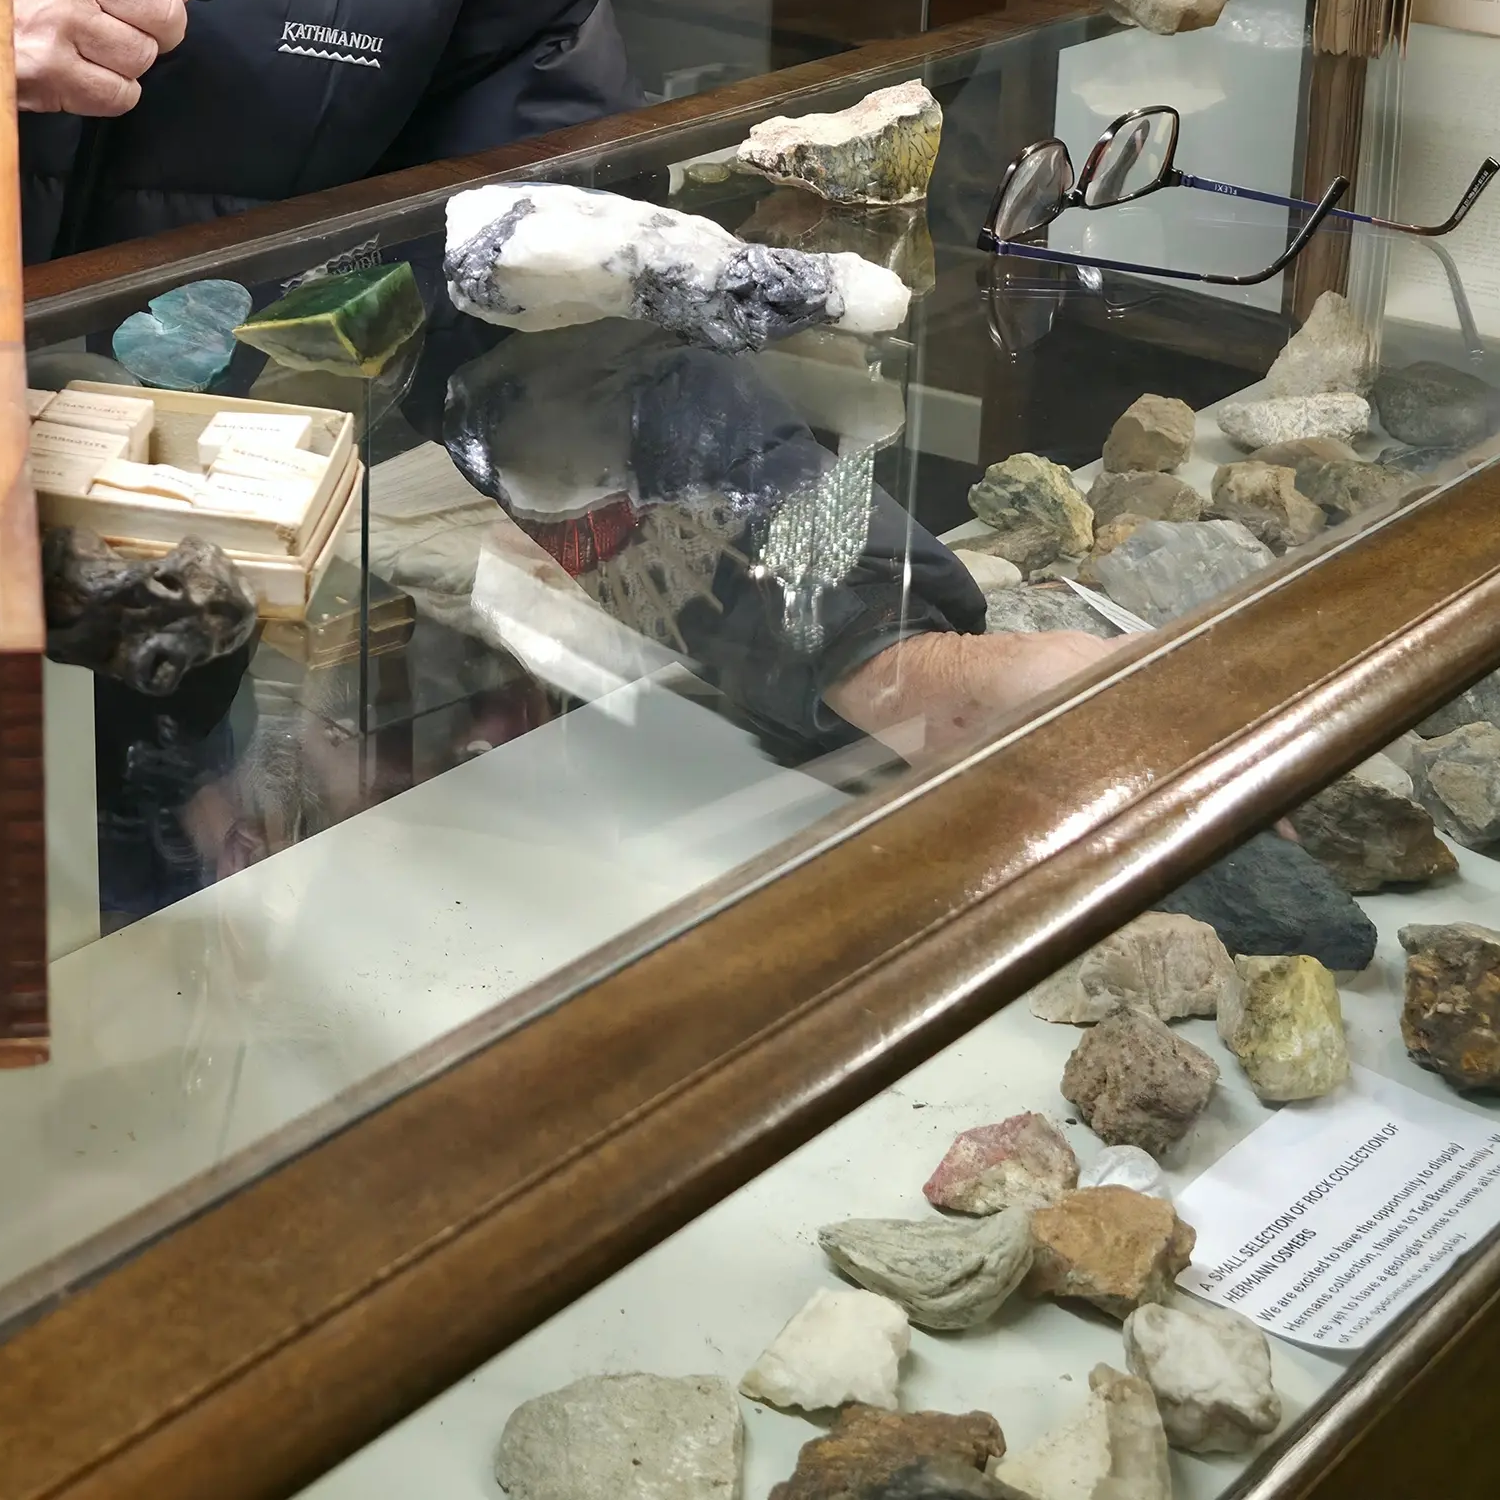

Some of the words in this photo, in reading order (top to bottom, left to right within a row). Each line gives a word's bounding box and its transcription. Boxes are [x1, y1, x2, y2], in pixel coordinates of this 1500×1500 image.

[280, 21, 384, 53] KATHMANDU
[1214, 183, 1238, 196] FLEXI
[1458, 1147, 1494, 1171] family
[1424, 1170, 1468, 1202] Brennan
[1199, 1283, 1215, 1293] A
[1208, 1255, 1248, 1282] SMALL
[1238, 1212, 1297, 1258] SELECTION
[1289, 1200, 1309, 1216] OF
[1301, 1178, 1337, 1205] ROCK
[1328, 1133, 1389, 1182] COLLECTION
[1381, 1122, 1399, 1136] OF
[1401, 1215, 1419, 1225] to
[1409, 1199, 1434, 1216] Ted
[1256, 1306, 1282, 1322] We
[1276, 1292, 1298, 1308] are
[1292, 1259, 1332, 1293] excited
[1323, 1252, 1341, 1262] to
[1332, 1233, 1362, 1253] have
[1355, 1219, 1378, 1234] the
[1372, 1177, 1427, 1221] opportunity
[1417, 1169, 1434, 1179] to
[1427, 1142, 1465, 1171] display
[1371, 1223, 1409, 1251] thanks
[1222, 1260, 1279, 1304] HERMANN
[1271, 1228, 1317, 1264] OSMERS
[1312, 1324, 1333, 1340] are
[1328, 1310, 1348, 1326] yet
[1340, 1301, 1359, 1311] to
[1350, 1281, 1381, 1302] have
[1382, 1238, 1427, 1277] geologist
[1421, 1217, 1450, 1240] come
[1442, 1208, 1460, 1217] to
[1455, 1186, 1483, 1209] name
[1477, 1175, 1494, 1187] all
[1327, 1252, 1382, 1294] collection,
[1282, 1292, 1333, 1332] Hermans
